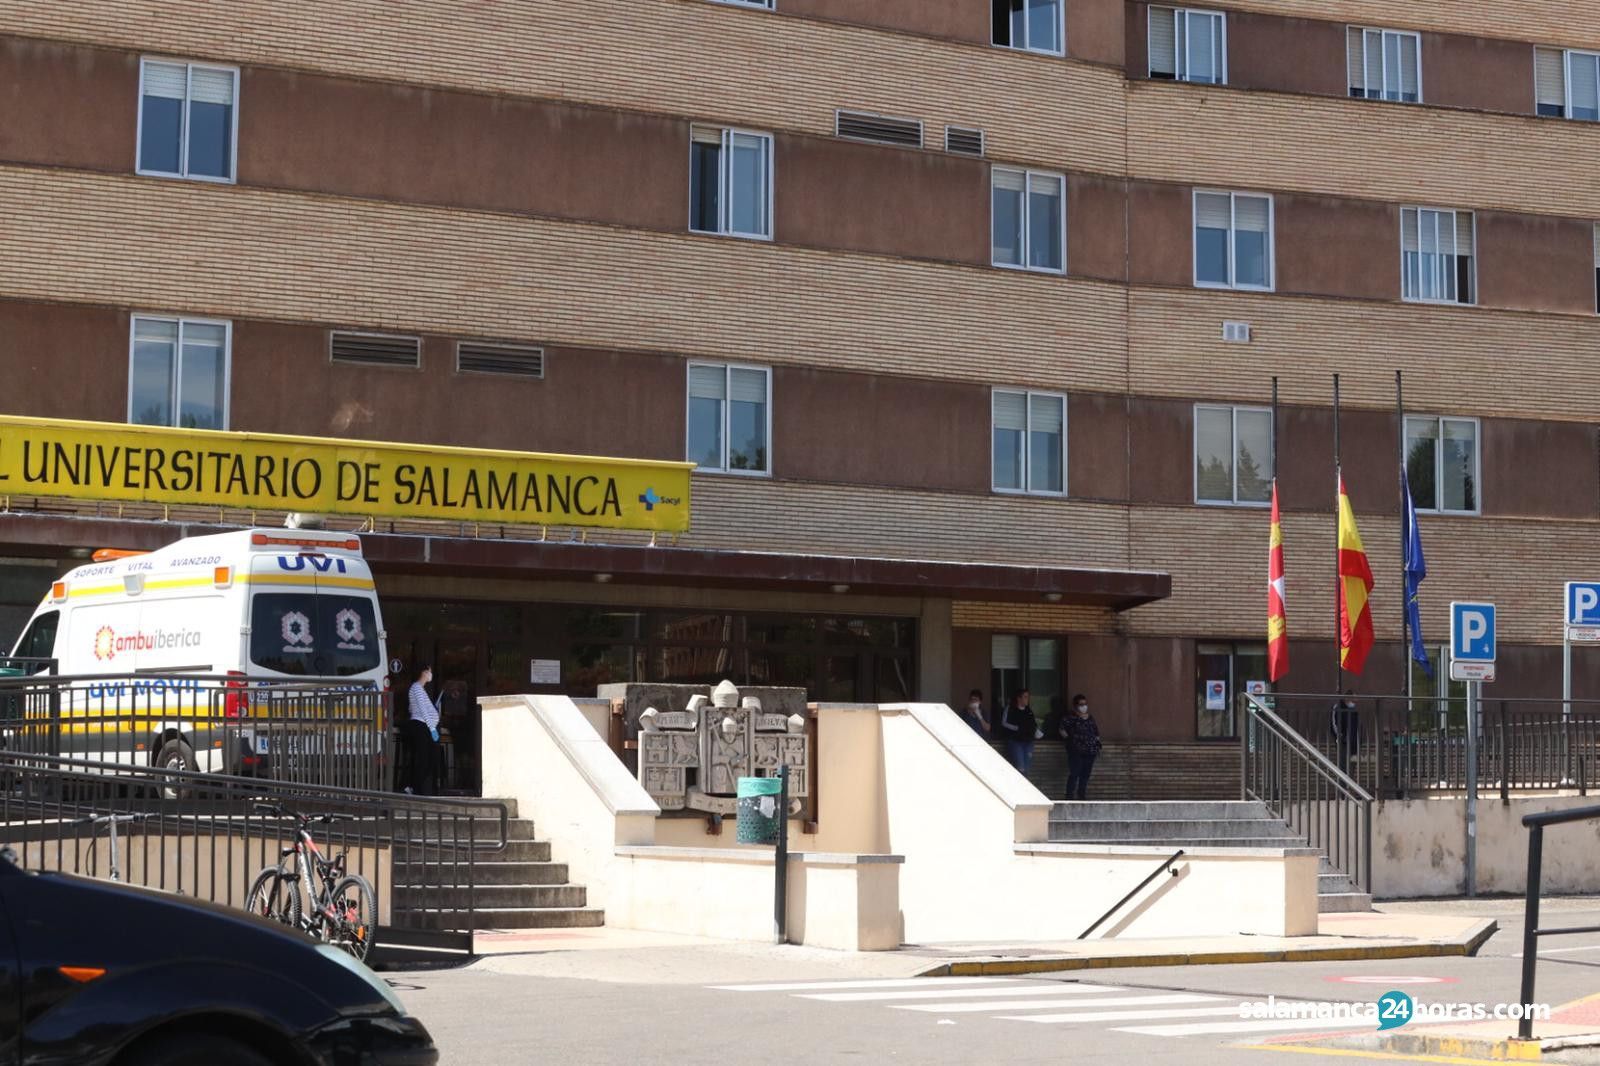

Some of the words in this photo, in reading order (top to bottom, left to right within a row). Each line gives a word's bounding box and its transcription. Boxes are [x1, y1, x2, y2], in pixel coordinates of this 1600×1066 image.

[24, 440, 322, 499] UNIVERSITARIO
[337, 460, 381, 503] DE
[394, 464, 622, 517] SALAMANCA
[660, 496, 681, 506] Sacyl
[74, 566, 115, 578] SOPORTE
[128, 562, 153, 571] VITAL
[170, 556, 221, 567] AVANZADO
[277, 556, 347, 573] UVI
[1575, 587, 1598, 623] P
[116, 628, 201, 651] ambuiberica
[1462, 611, 1487, 653] P
[89, 681, 126, 699] UVI
